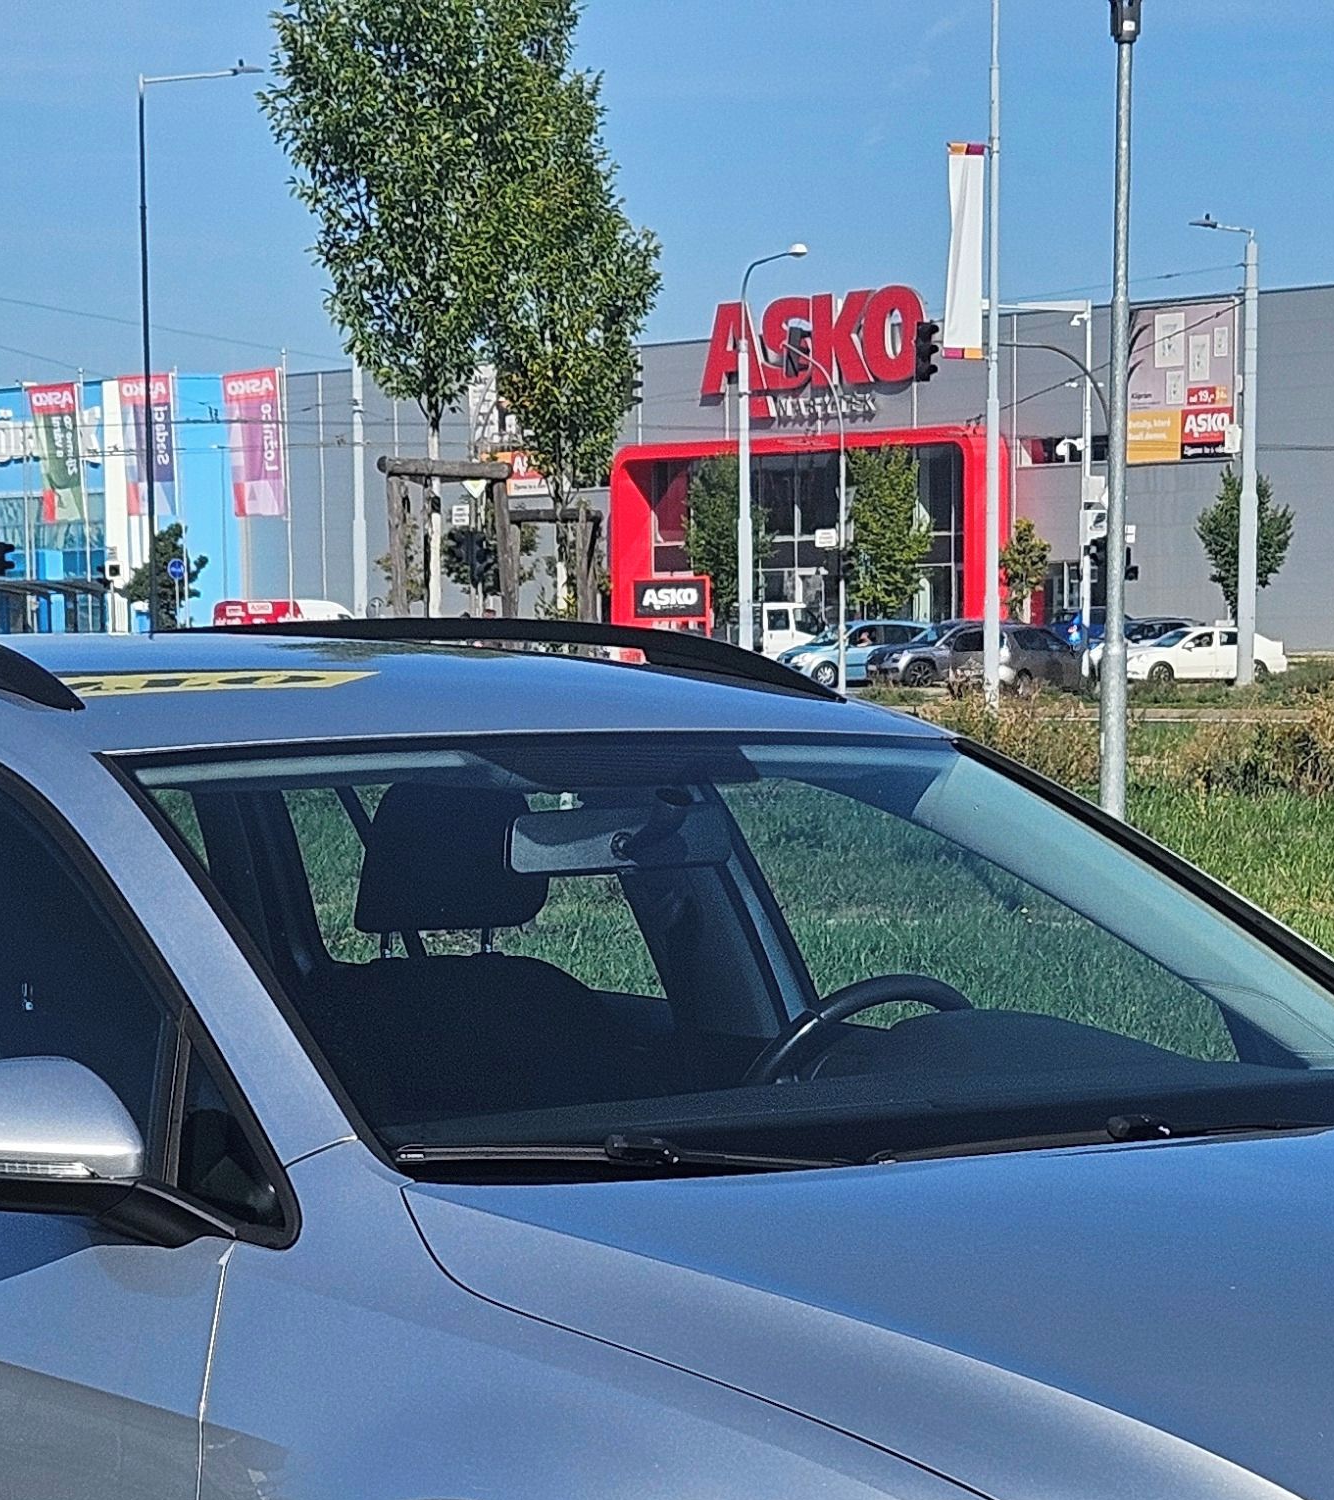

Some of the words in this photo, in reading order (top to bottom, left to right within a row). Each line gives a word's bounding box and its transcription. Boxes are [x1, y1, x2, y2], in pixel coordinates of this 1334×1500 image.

[700, 284, 926, 396] ASKO
[1184, 413, 1229, 434] ASKO
[643, 588, 698, 608] ASKO
